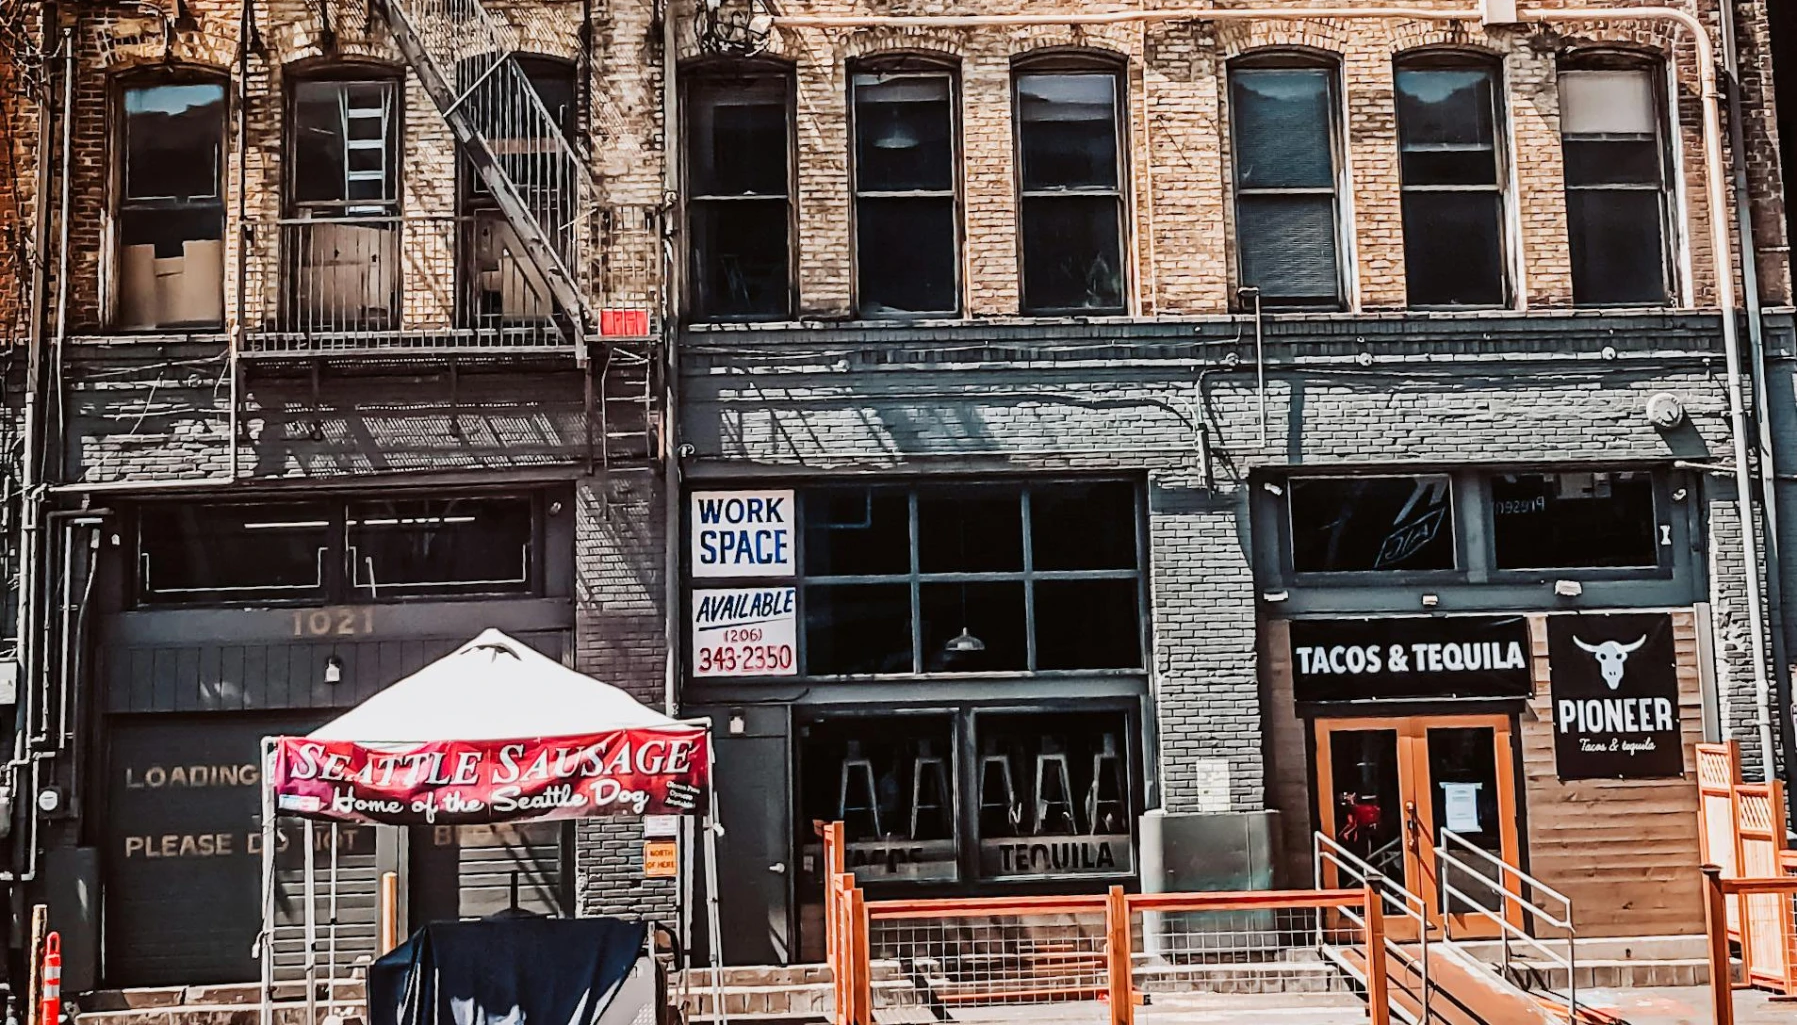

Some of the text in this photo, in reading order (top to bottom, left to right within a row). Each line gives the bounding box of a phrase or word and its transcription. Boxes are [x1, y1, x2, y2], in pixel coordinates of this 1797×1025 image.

[698, 497, 784, 524] WORK
[700, 529, 788, 565] SPACE
[695, 589, 795, 623] AVAILABLE
[292, 607, 374, 636] 1021
[723, 628, 763, 643] (206)
[698, 645, 793, 672] 343-2350
[1295, 641, 1526, 674] TACOS & TEQUILA
[1558, 697, 1674, 734] PIONEER
[1579, 736, 1656, 756] Tacos & tequila
[125, 764, 260, 788] LOADING
[290, 739, 693, 787] SEATTLE SAUSAGE
[332, 785, 404, 814] Home
[411, 790, 439, 824] of
[440, 789, 485, 813] the
[490, 783, 589, 812] Seattle
[589, 778, 650, 814] Dog
[125, 833, 234, 858] PLEASE
[650, 849, 673, 857] NORTH
[845, 841, 1116, 873] ACOS TEQUILA
[646, 861, 674, 869] OF HERE
